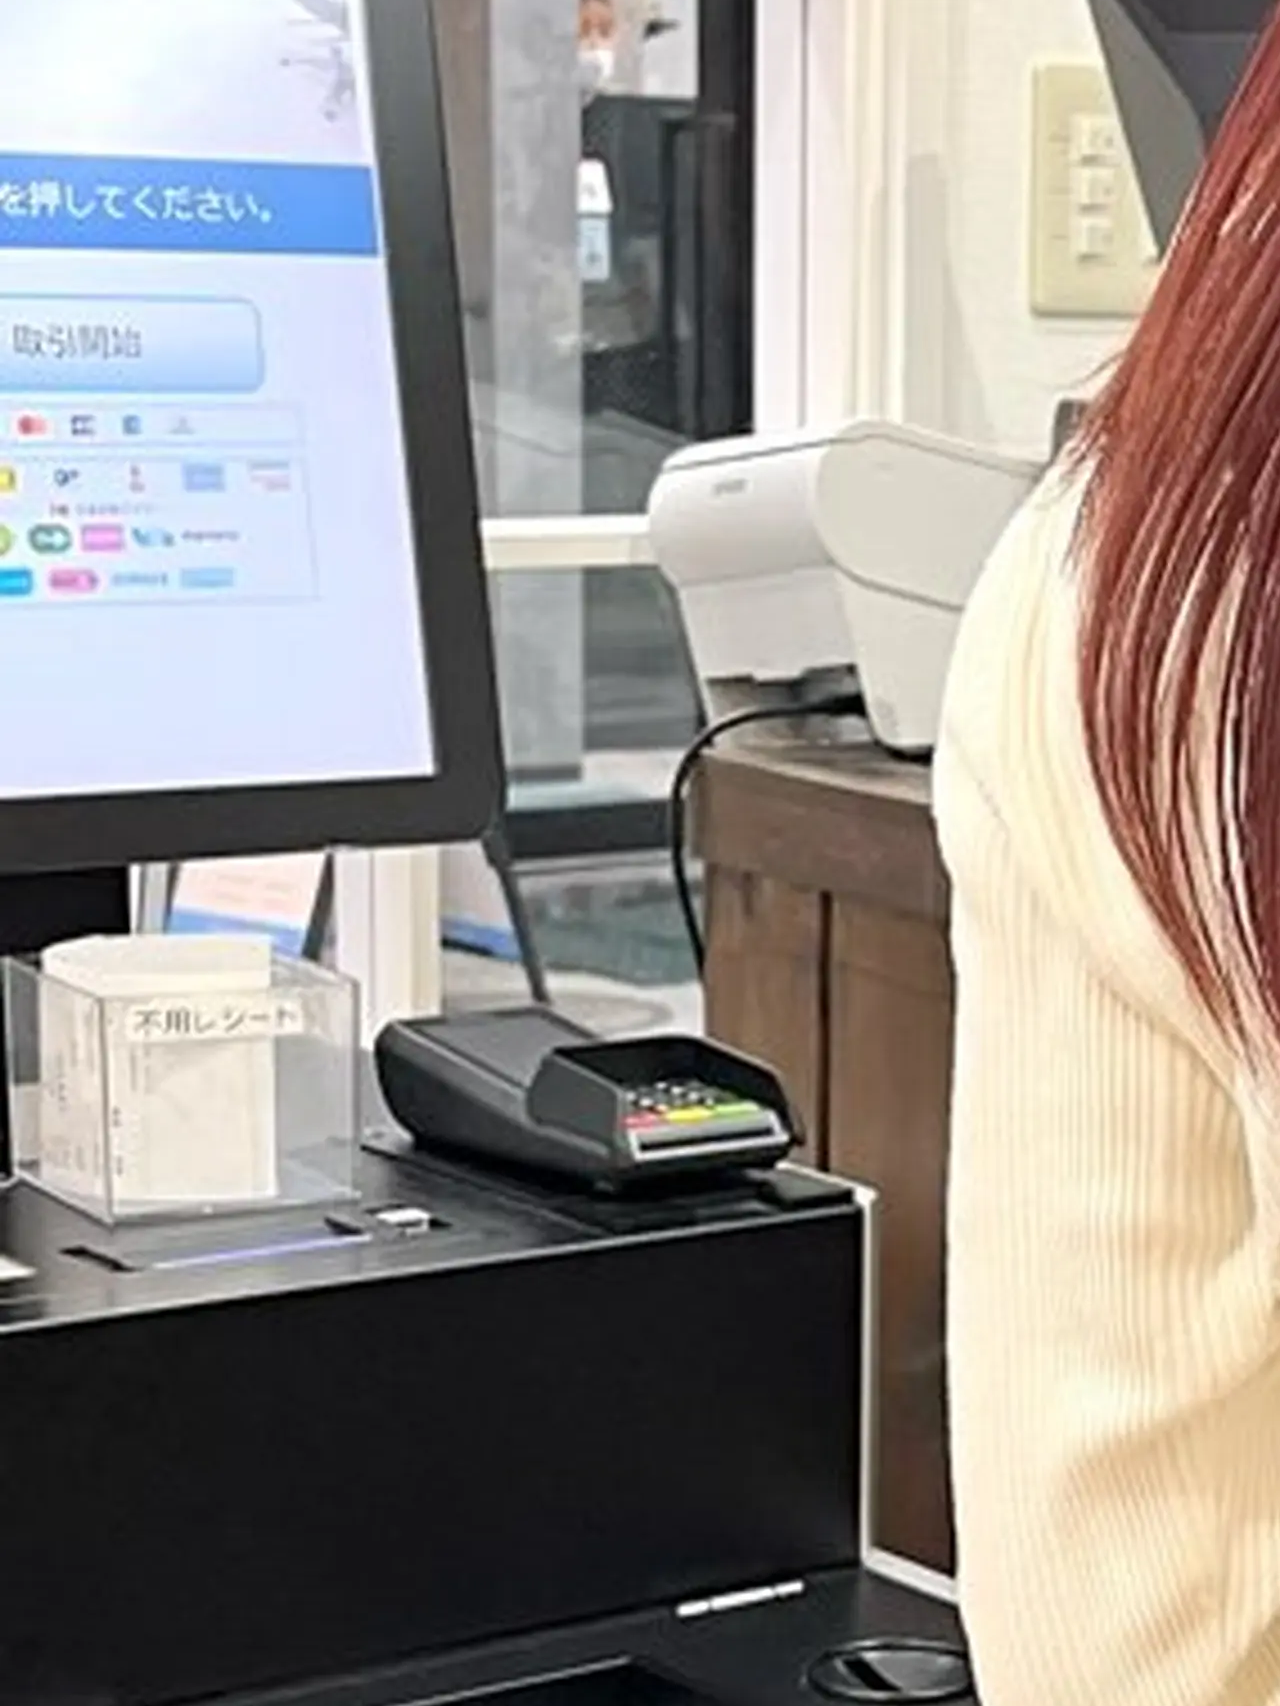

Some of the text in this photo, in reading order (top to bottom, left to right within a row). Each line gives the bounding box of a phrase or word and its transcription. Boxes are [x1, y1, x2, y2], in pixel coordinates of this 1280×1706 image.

[132, 1003, 300, 1036] 不用レシート
